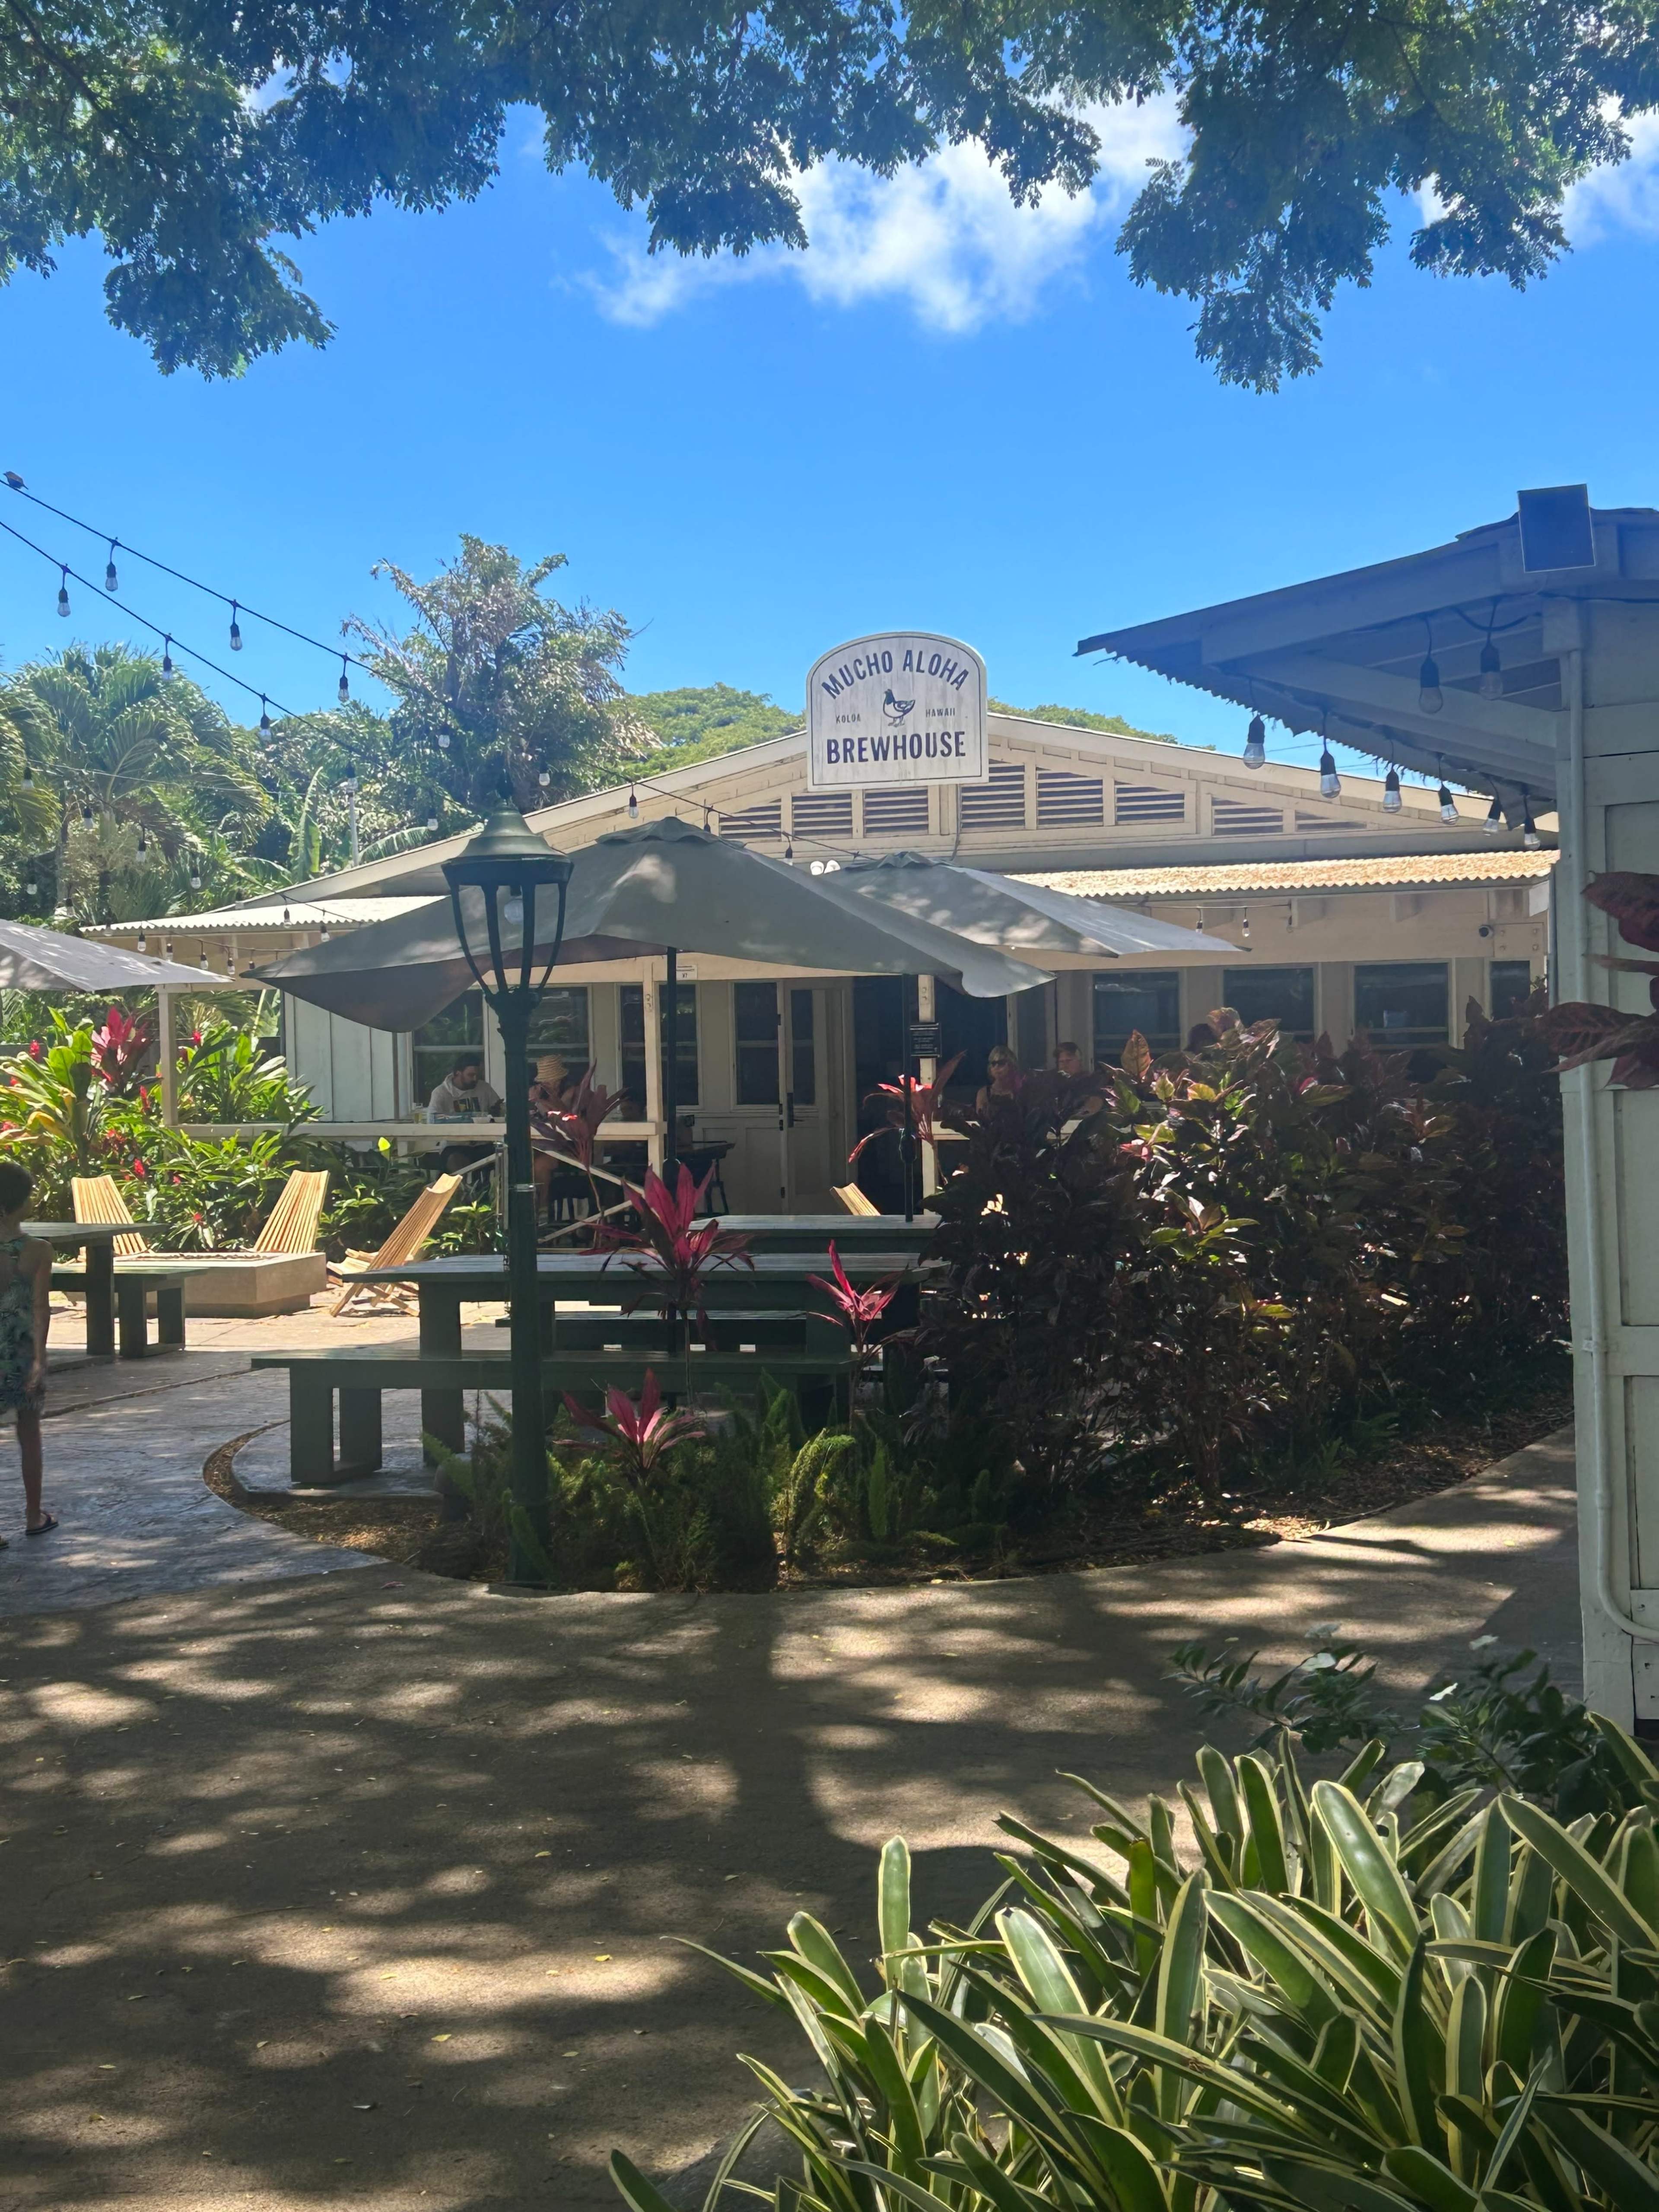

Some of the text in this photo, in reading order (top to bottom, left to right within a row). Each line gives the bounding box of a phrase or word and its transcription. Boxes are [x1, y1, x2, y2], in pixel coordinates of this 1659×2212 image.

[821, 650, 969, 699] MUCHO ALOHA
[836, 708, 955, 724] KOLOA HAWAII
[826, 731, 966, 764] BREWHOUSE
